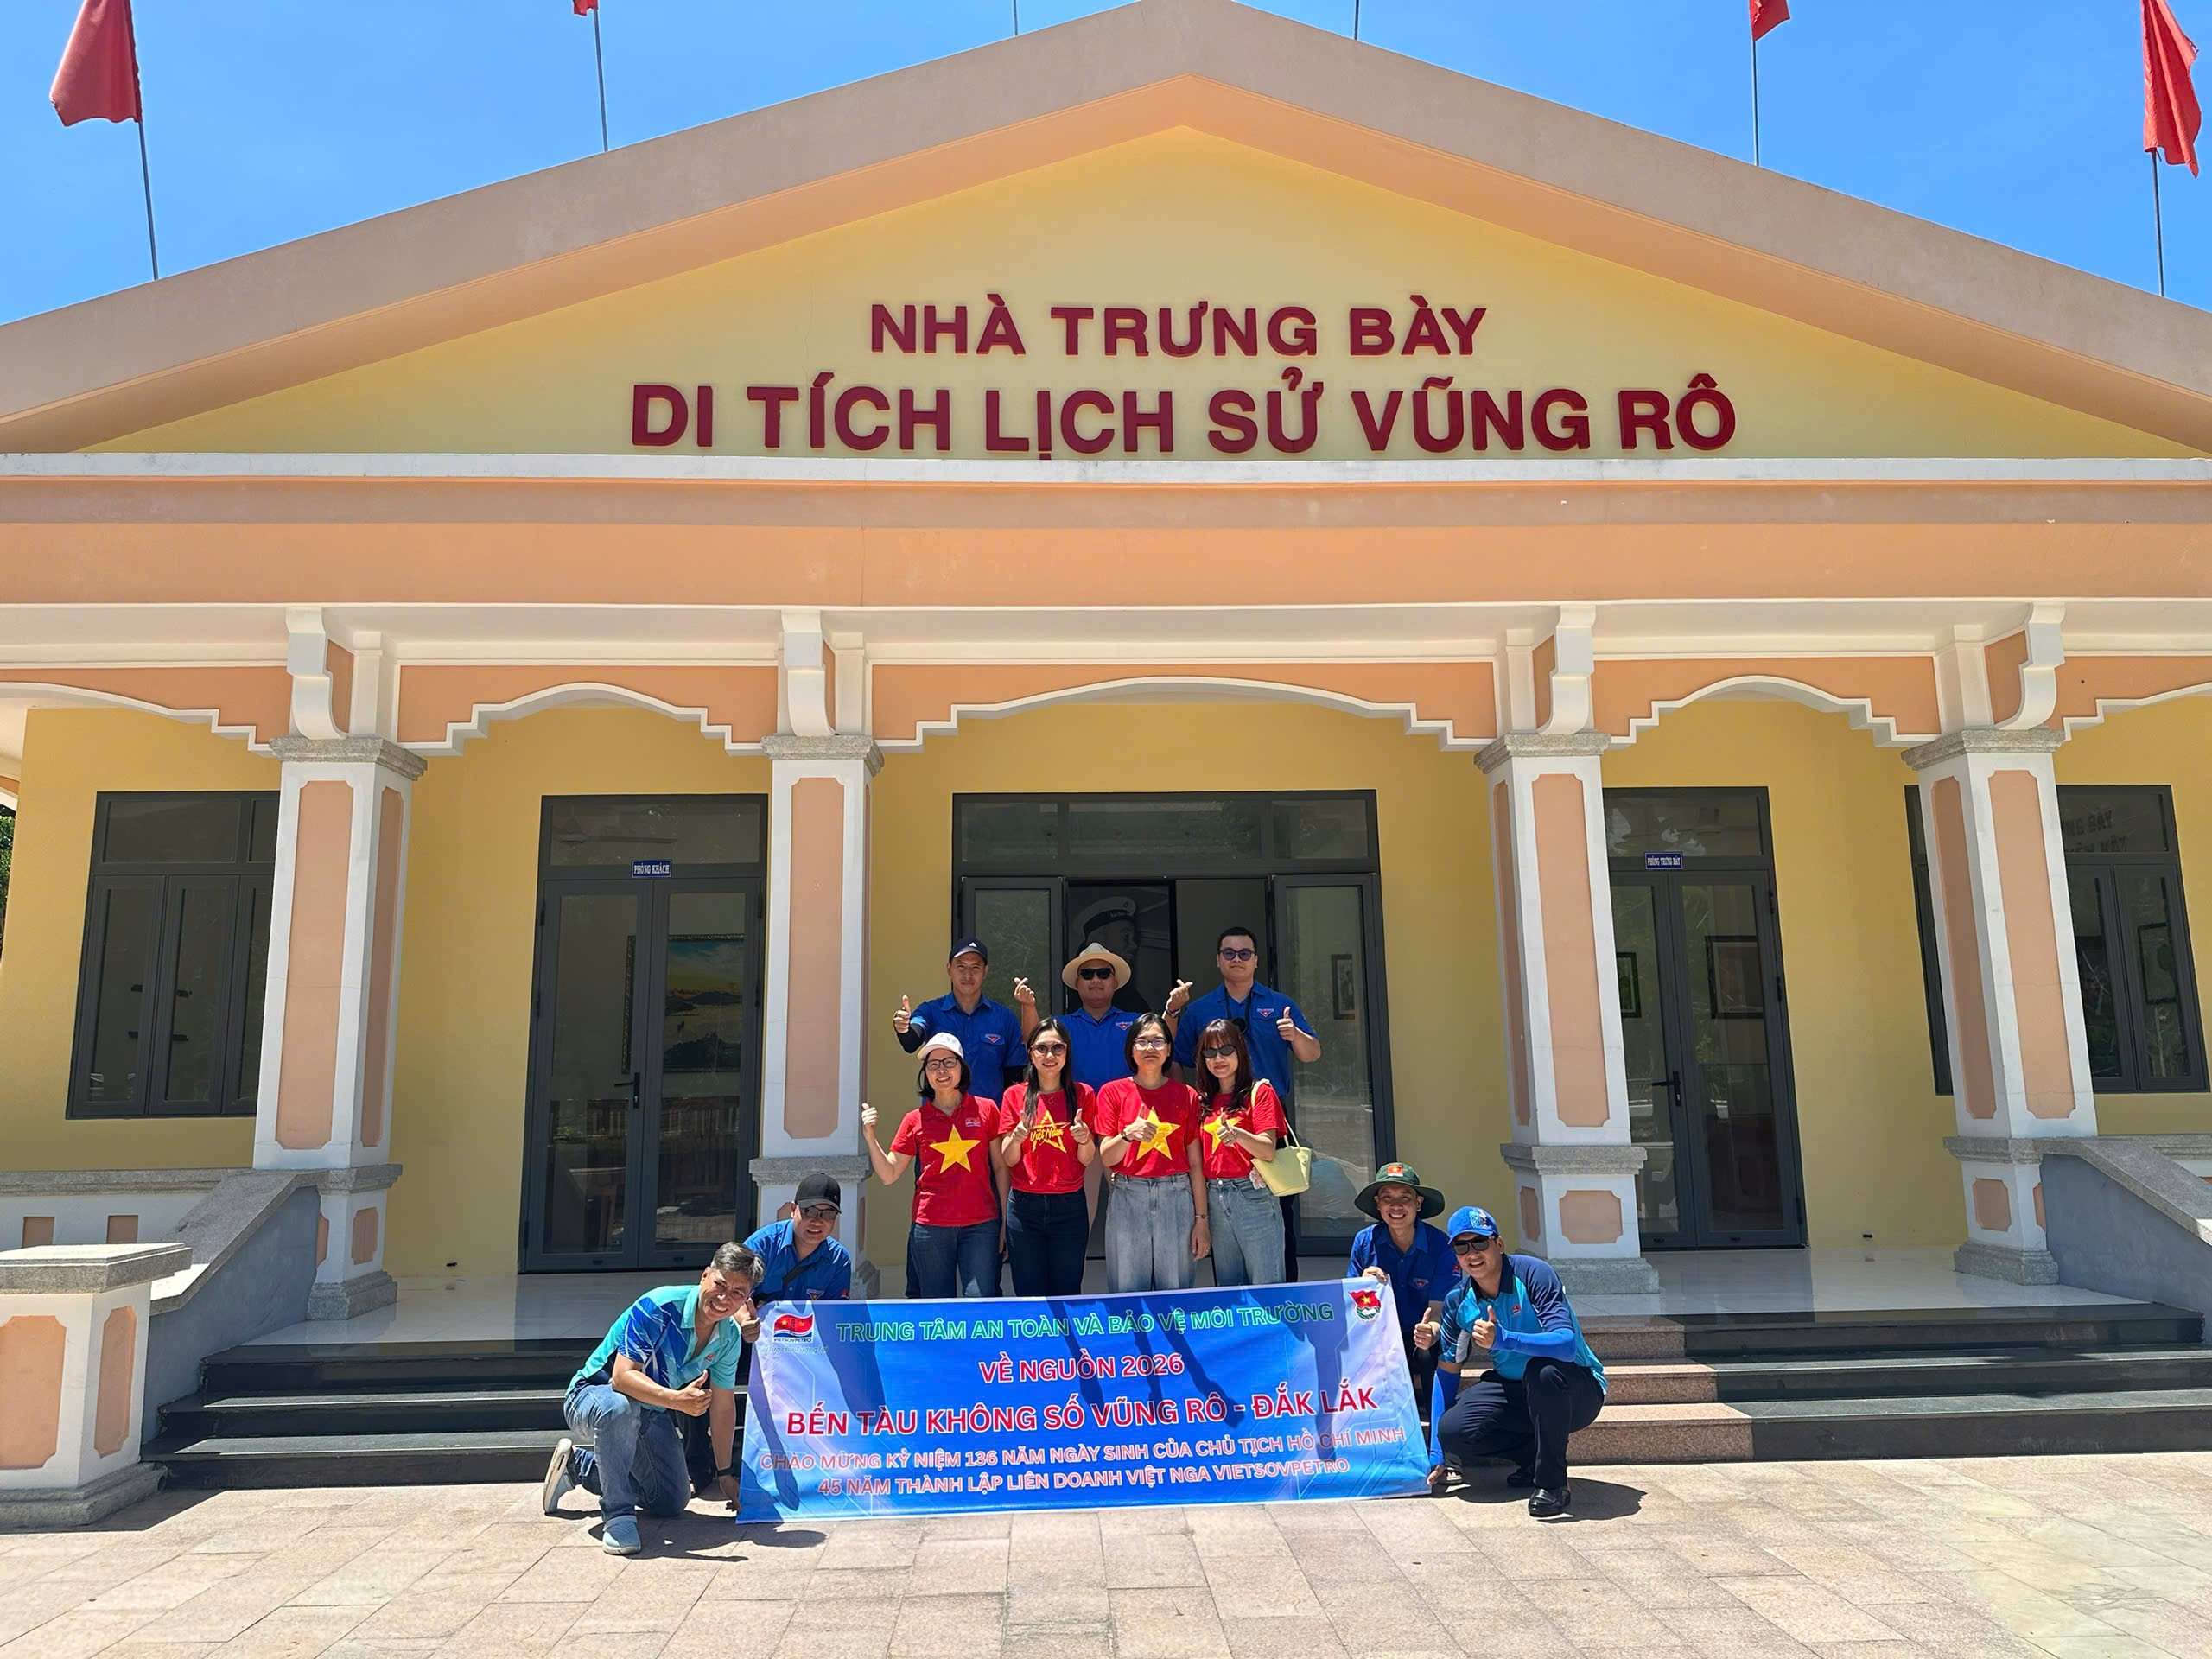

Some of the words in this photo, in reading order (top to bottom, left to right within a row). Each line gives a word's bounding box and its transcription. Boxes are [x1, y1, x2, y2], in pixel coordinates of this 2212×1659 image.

[871, 293, 1026, 355] NHÀ
[1051, 300, 1317, 357] TRƯNG
[1350, 295, 1487, 356] BÀY
[632, 385, 713, 448] DI
[747, 372, 950, 451] TÍCH
[986, 389, 1174, 461] LỊCH
[1208, 366, 1324, 454] SỬ
[1351, 376, 1591, 452] VŨNG
[1618, 372, 1736, 452] RÔ
[836, 1322, 918, 1342] TRUNG
[919, 1318, 967, 1340] TÂM
[971, 1319, 1005, 1339] AN
[1009, 1314, 1068, 1338] TOÀN
[1074, 1312, 1103, 1336] VÀ
[1109, 1310, 1154, 1333] BẢO
[1160, 1308, 1185, 1334] VỆ
[1191, 1305, 1233, 1329] MÔI
[1240, 1301, 1333, 1326] TRƯỜNG
[979, 1351, 1013, 1383] VỀ
[1020, 1348, 1116, 1382] NGUỒN
[1122, 1353, 1184, 1376] 2026
[786, 1402, 849, 1436] BẾN
[858, 1406, 917, 1436] TÀU
[926, 1402, 1036, 1434] KHÔNG
[1044, 1394, 1084, 1429] SỐ
[1090, 1395, 1178, 1428] VŨNG
[1185, 1392, 1227, 1422] RÔ
[1252, 1382, 1313, 1419] ĐẮK
[1321, 1378, 1378, 1414] LẮK
[760, 1449, 815, 1471] CHÀO
[820, 1452, 880, 1469] MỪNG
[886, 1447, 909, 1469] KỶ
[914, 1449, 961, 1471] NIỆM
[965, 1451, 997, 1468] 136
[1002, 1446, 1045, 1465] NĂM
[1050, 1442, 1100, 1464] NGÀY
[1103, 1443, 1148, 1461] SINH
[1153, 1438, 1192, 1459] CỦA
[1196, 1434, 1236, 1456] CHỦ
[1239, 1437, 1283, 1455] TỊCH
[1288, 1428, 1315, 1452] HỒ
[1319, 1432, 1351, 1450] CHÍ
[1357, 1427, 1405, 1445] MINH
[818, 1479, 842, 1496] 45
[846, 1476, 893, 1495] NĂM
[896, 1475, 963, 1494] THÀNH
[968, 1474, 1003, 1495] LẬP
[1007, 1471, 1049, 1491] LIÊN
[1054, 1471, 1122, 1490] DOANH
[1126, 1465, 1166, 1489] VIỆT
[1170, 1466, 1210, 1484] NGA
[1214, 1458, 1349, 1481] VIETSOVPETRO
